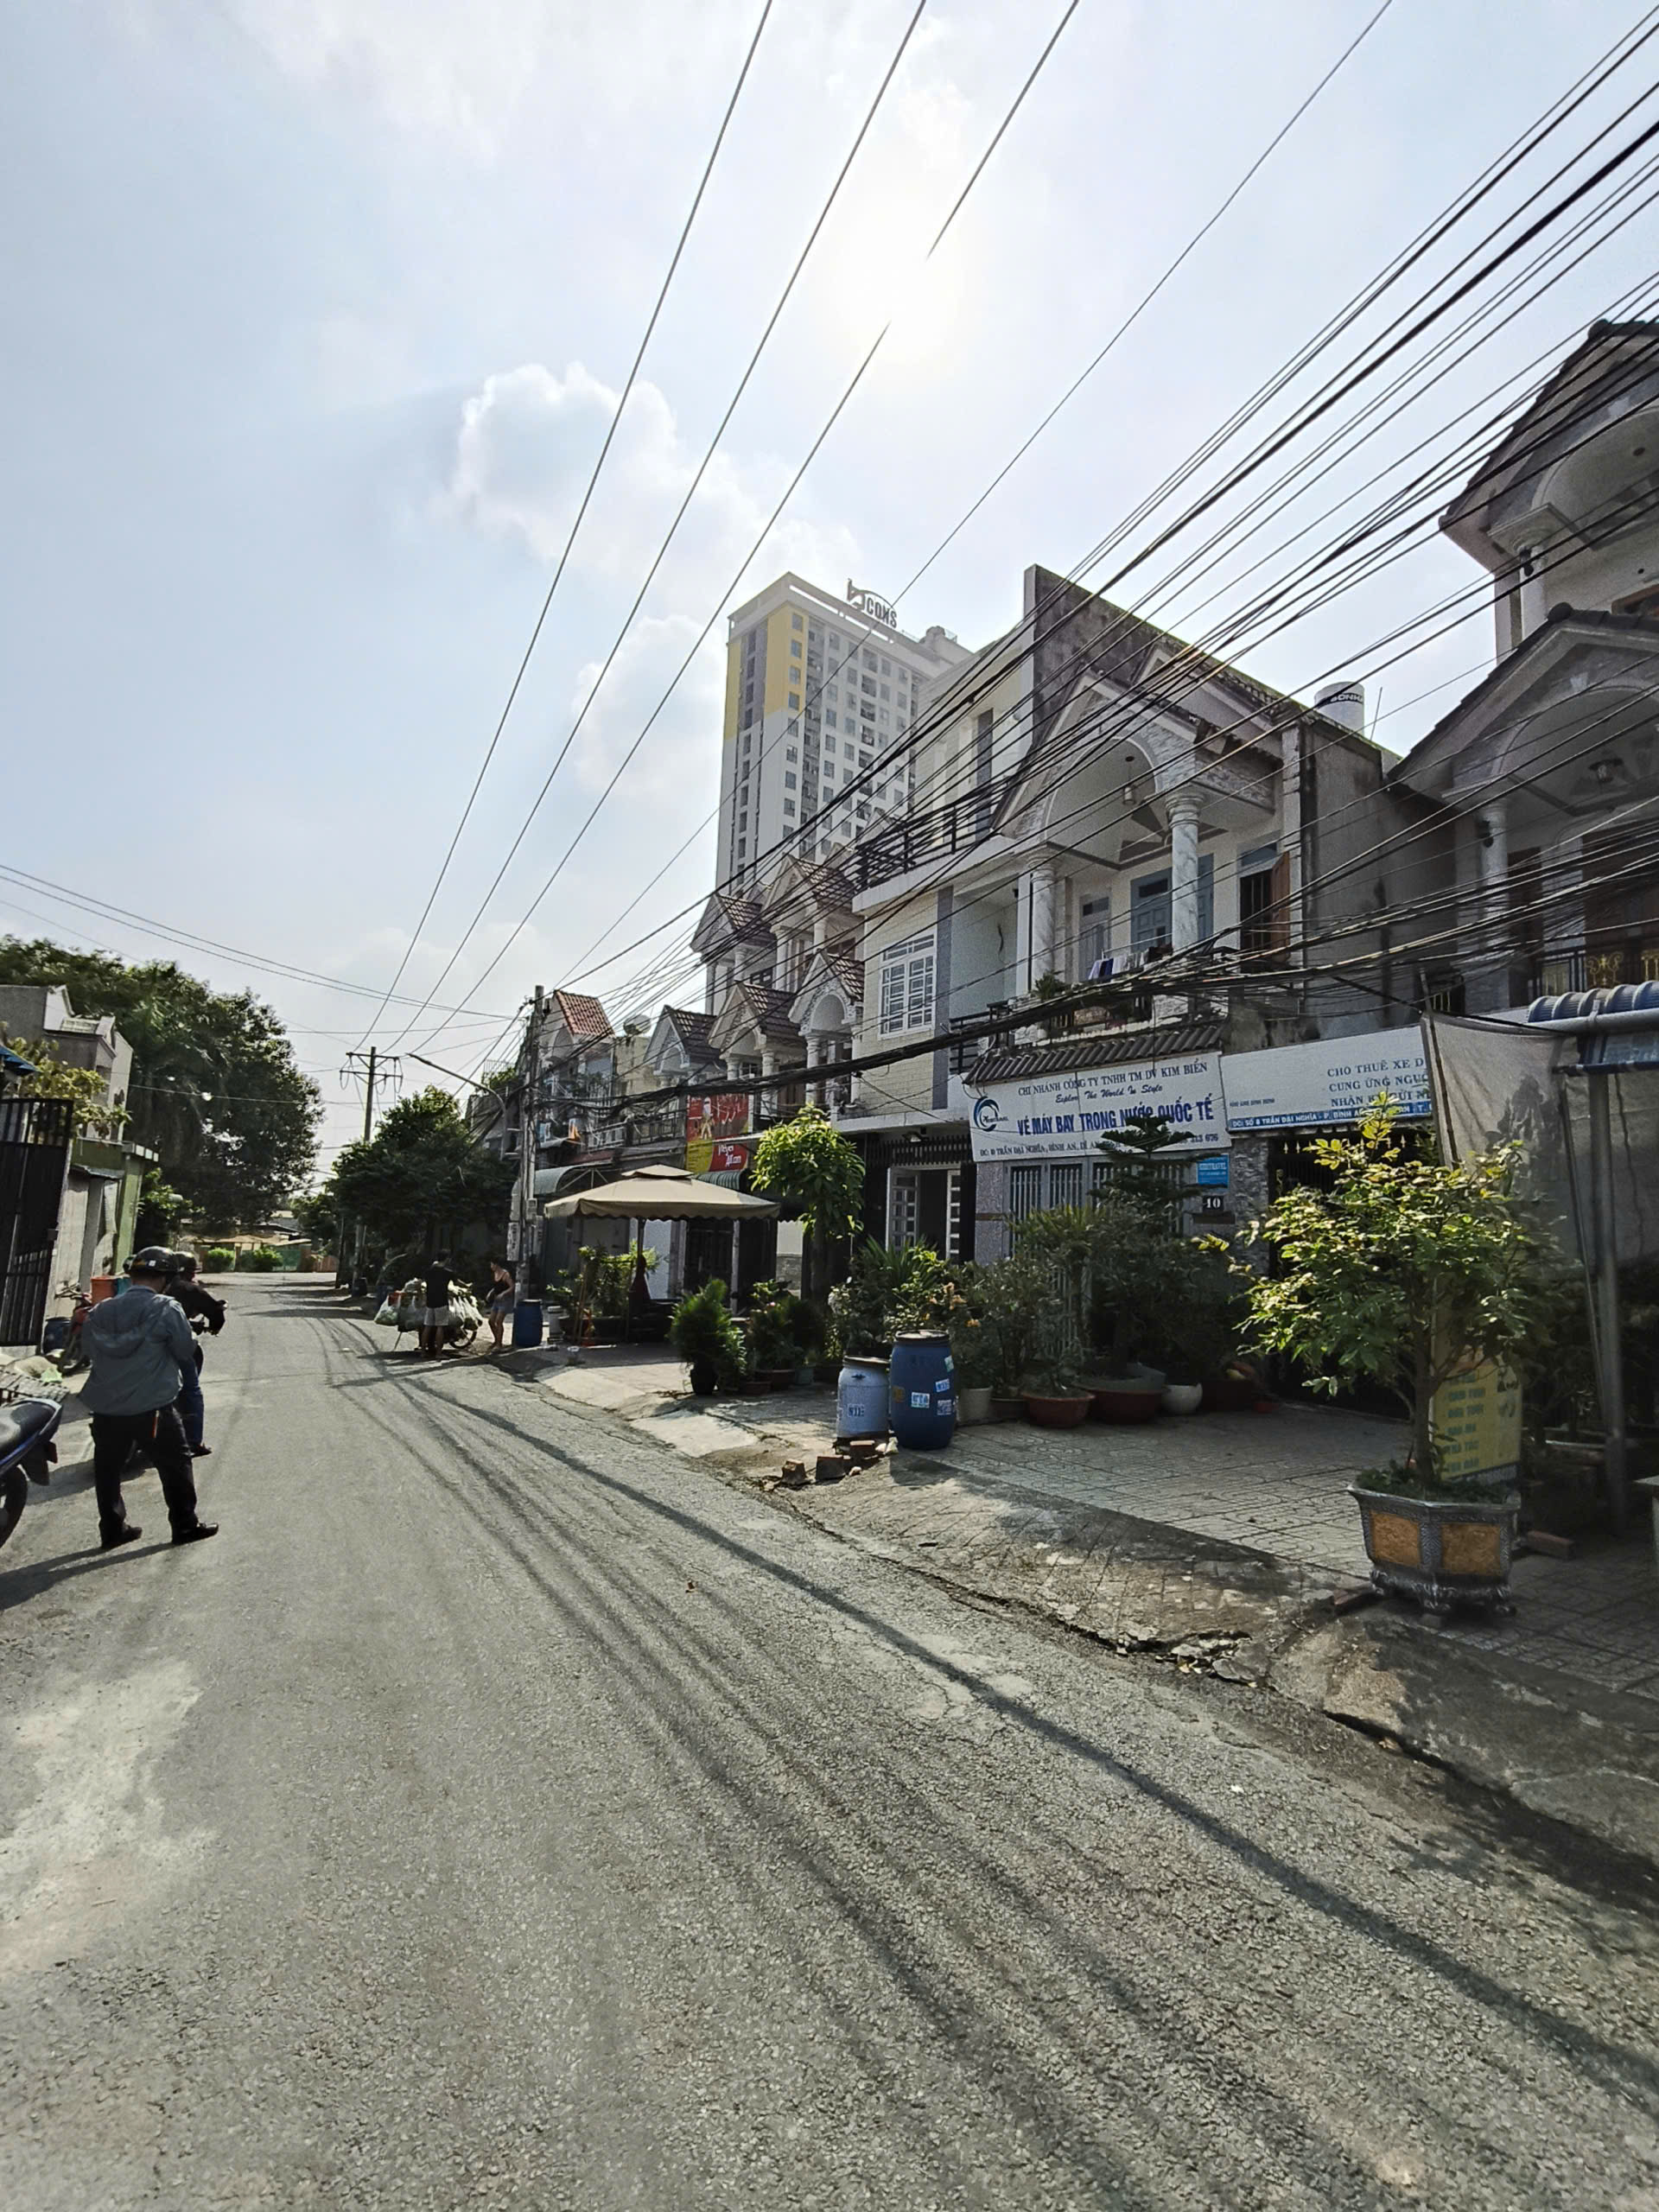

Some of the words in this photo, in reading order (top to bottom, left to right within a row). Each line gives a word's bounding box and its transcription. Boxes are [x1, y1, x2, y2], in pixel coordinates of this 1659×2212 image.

[1327, 1066, 1351, 1077] CHO
[1356, 1059, 1389, 1074] THUÊ
[1393, 1058, 1410, 1070] XE
[1033, 1082, 1060, 1094] NHÁNH
[1063, 1078, 1086, 1090] CÔNG
[1087, 1077, 1098, 1086] TY
[1101, 1074, 1126, 1085] TNHH
[1128, 1071, 1142, 1082] TM
[1146, 1069, 1157, 1079] DV
[1161, 1066, 1180, 1077] KIM
[1329, 1080, 1361, 1092] CUNG
[1084, 1090, 1097, 1099] The
[1101, 1089, 1123, 1098] World
[1128, 1085, 1136, 1095] In
[1141, 1084, 1162, 1094] Style
[1032, 1114, 1052, 1135] MÁY
[1055, 1114, 1074, 1134] BAY
[1078, 1109, 1116, 1131] TRONG
[1196, 1093, 1214, 1120] TẾ
[1206, 1198, 1221, 1209] 10
